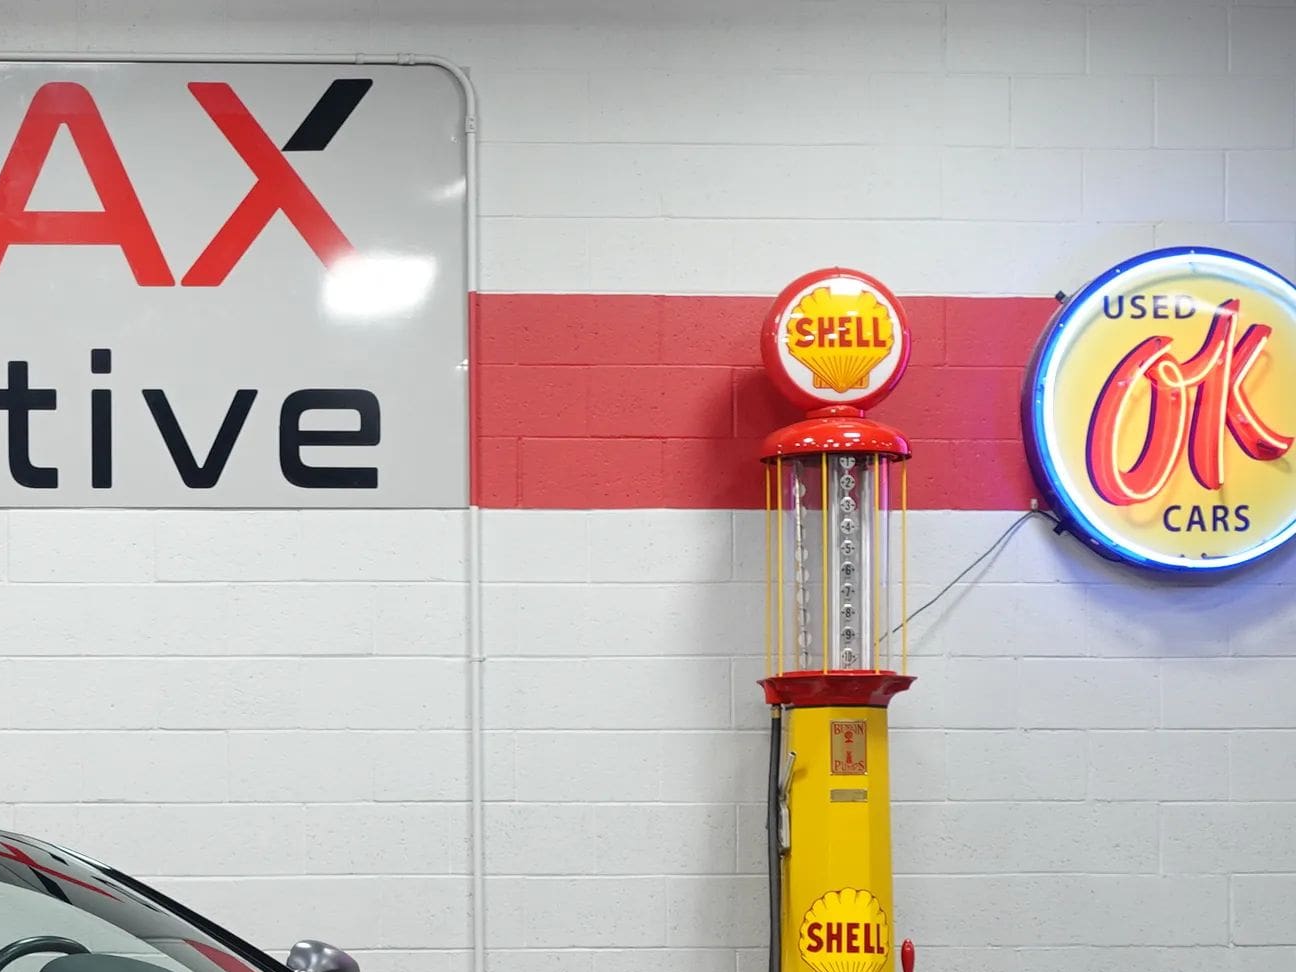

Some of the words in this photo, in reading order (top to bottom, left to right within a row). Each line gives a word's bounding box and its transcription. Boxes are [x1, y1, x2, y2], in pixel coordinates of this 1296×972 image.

[1103, 294, 1197, 319] USED
[795, 317, 887, 348] SHELL
[1085, 298, 1294, 506] OK
[1163, 505, 1251, 532] CARS
[806, 922, 885, 954] SHELL
